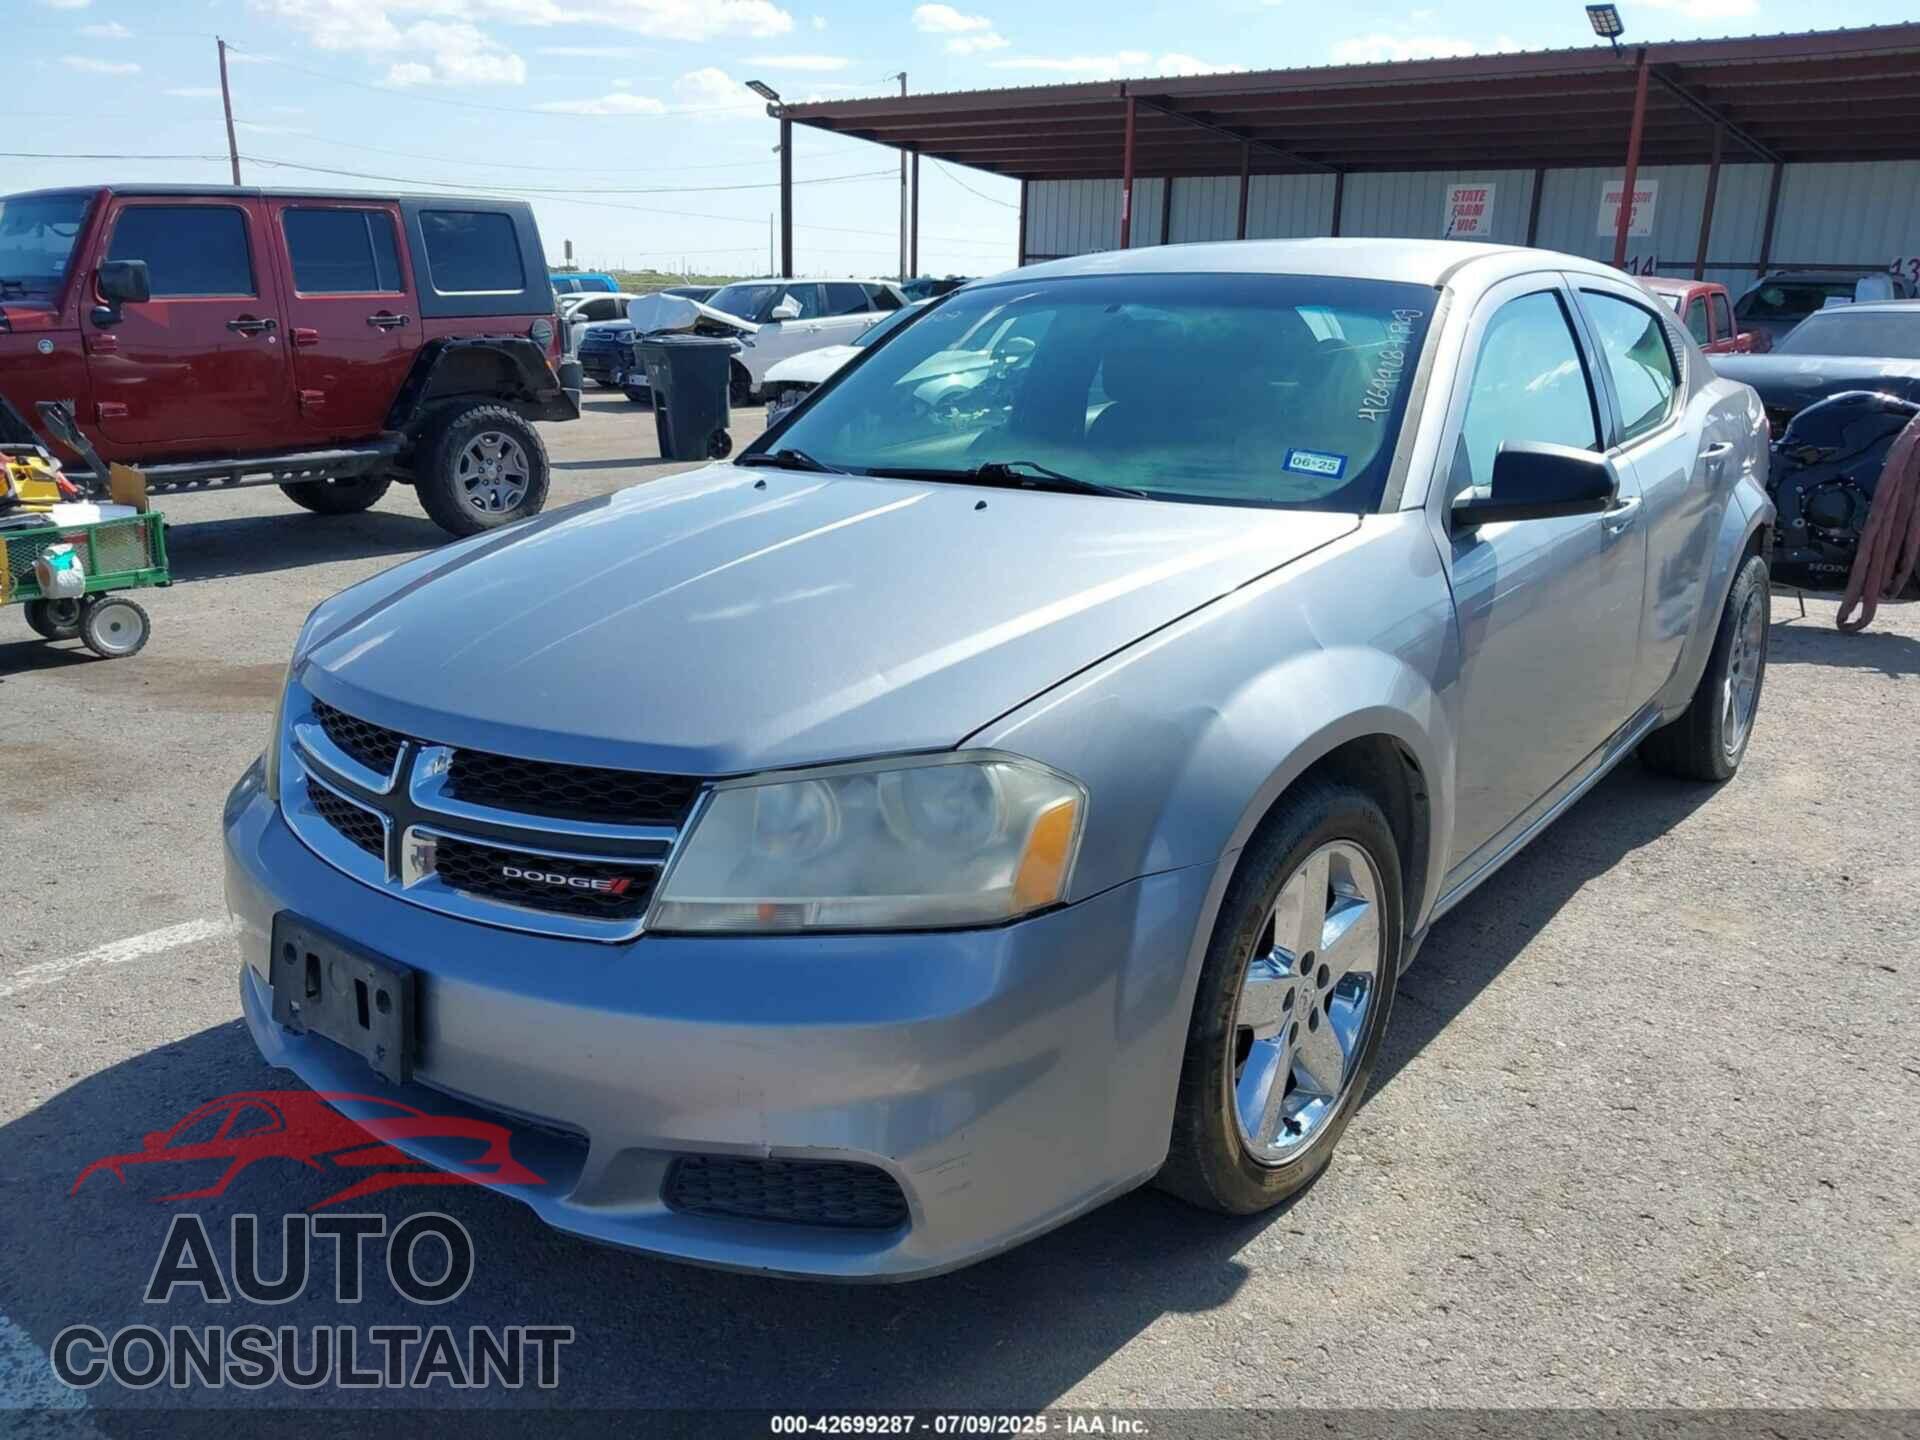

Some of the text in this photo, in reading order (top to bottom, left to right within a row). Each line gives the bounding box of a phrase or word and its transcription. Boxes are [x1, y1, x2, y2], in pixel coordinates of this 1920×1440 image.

[1452, 190, 1487, 202] STATE
[1451, 204, 1484, 217] FARM
[1456, 218, 1478, 232] VIC
[1630, 255, 1653, 276] 14
[502, 866, 612, 891] DODGE
